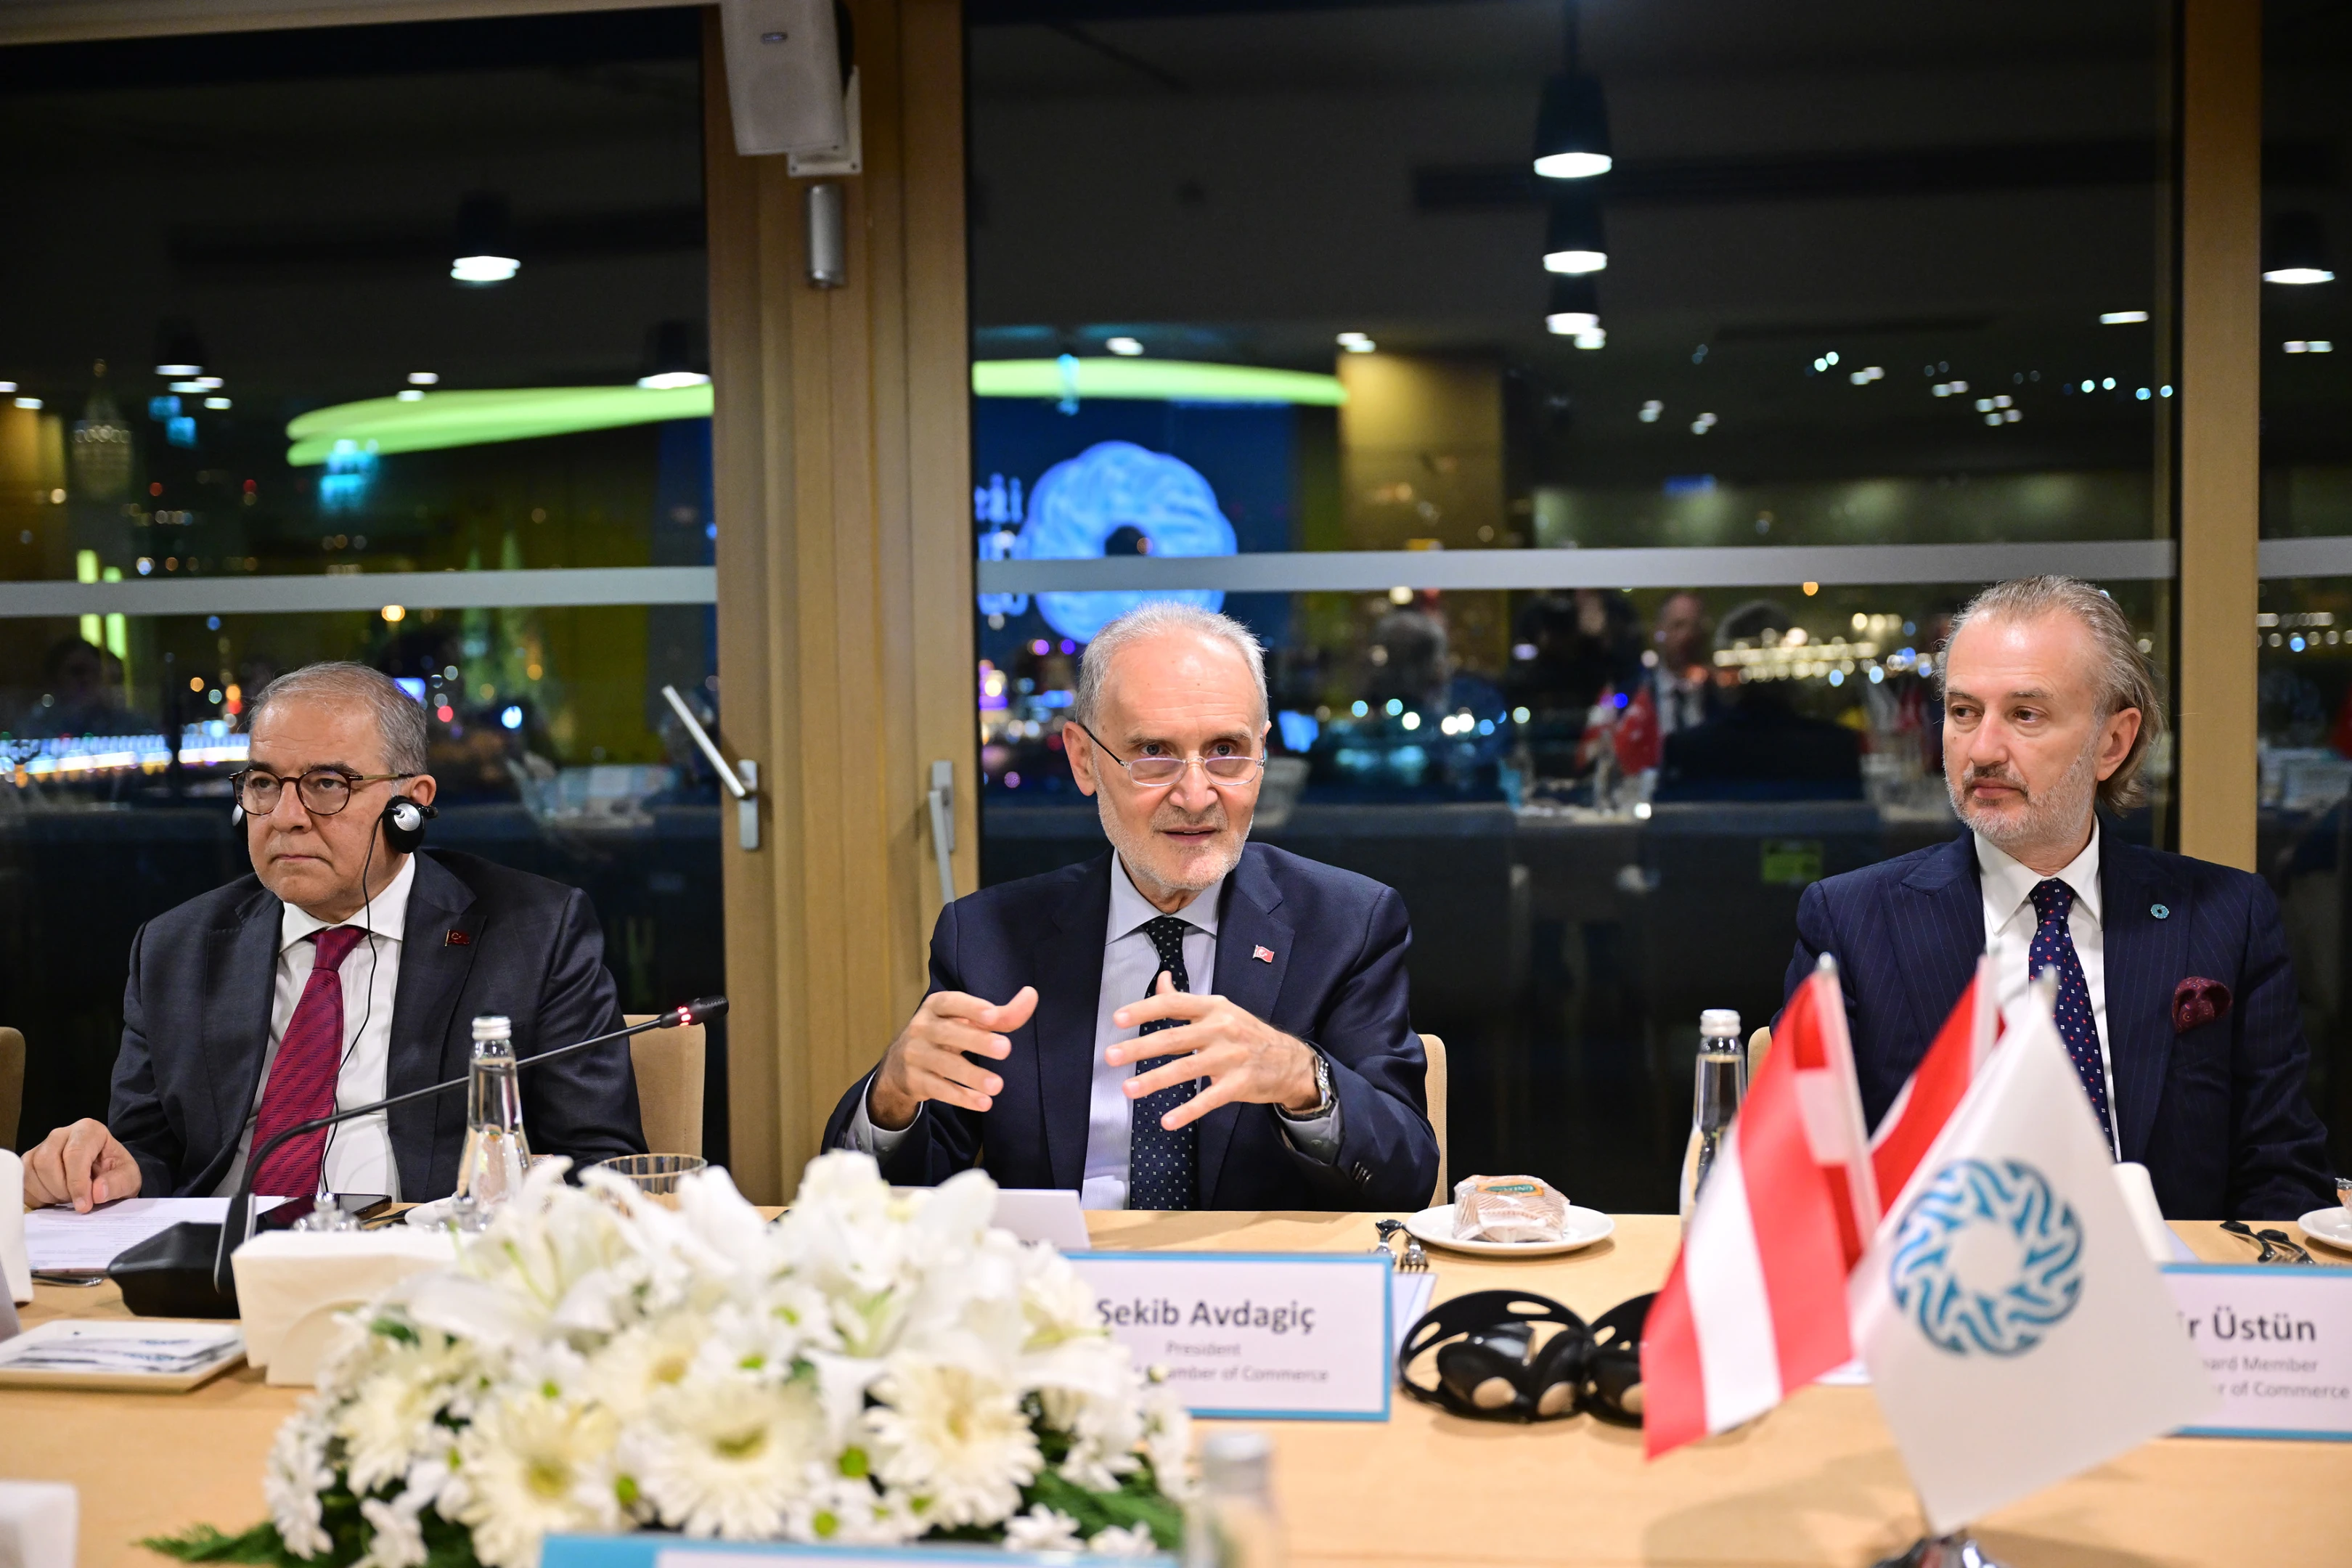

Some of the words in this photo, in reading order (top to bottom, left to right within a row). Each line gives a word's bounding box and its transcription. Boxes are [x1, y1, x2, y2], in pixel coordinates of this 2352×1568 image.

[1188, 1299, 1315, 1334] Avdagiç
[2213, 1305, 2316, 1342] Üstün
[1166, 1341, 1241, 1356] President
[2242, 1356, 2318, 1373] Member
[1222, 1366, 1240, 1381] of
[1242, 1366, 1328, 1382] Commerce
[2231, 1381, 2249, 1396] of
[2254, 1382, 2350, 1399] Commerce
